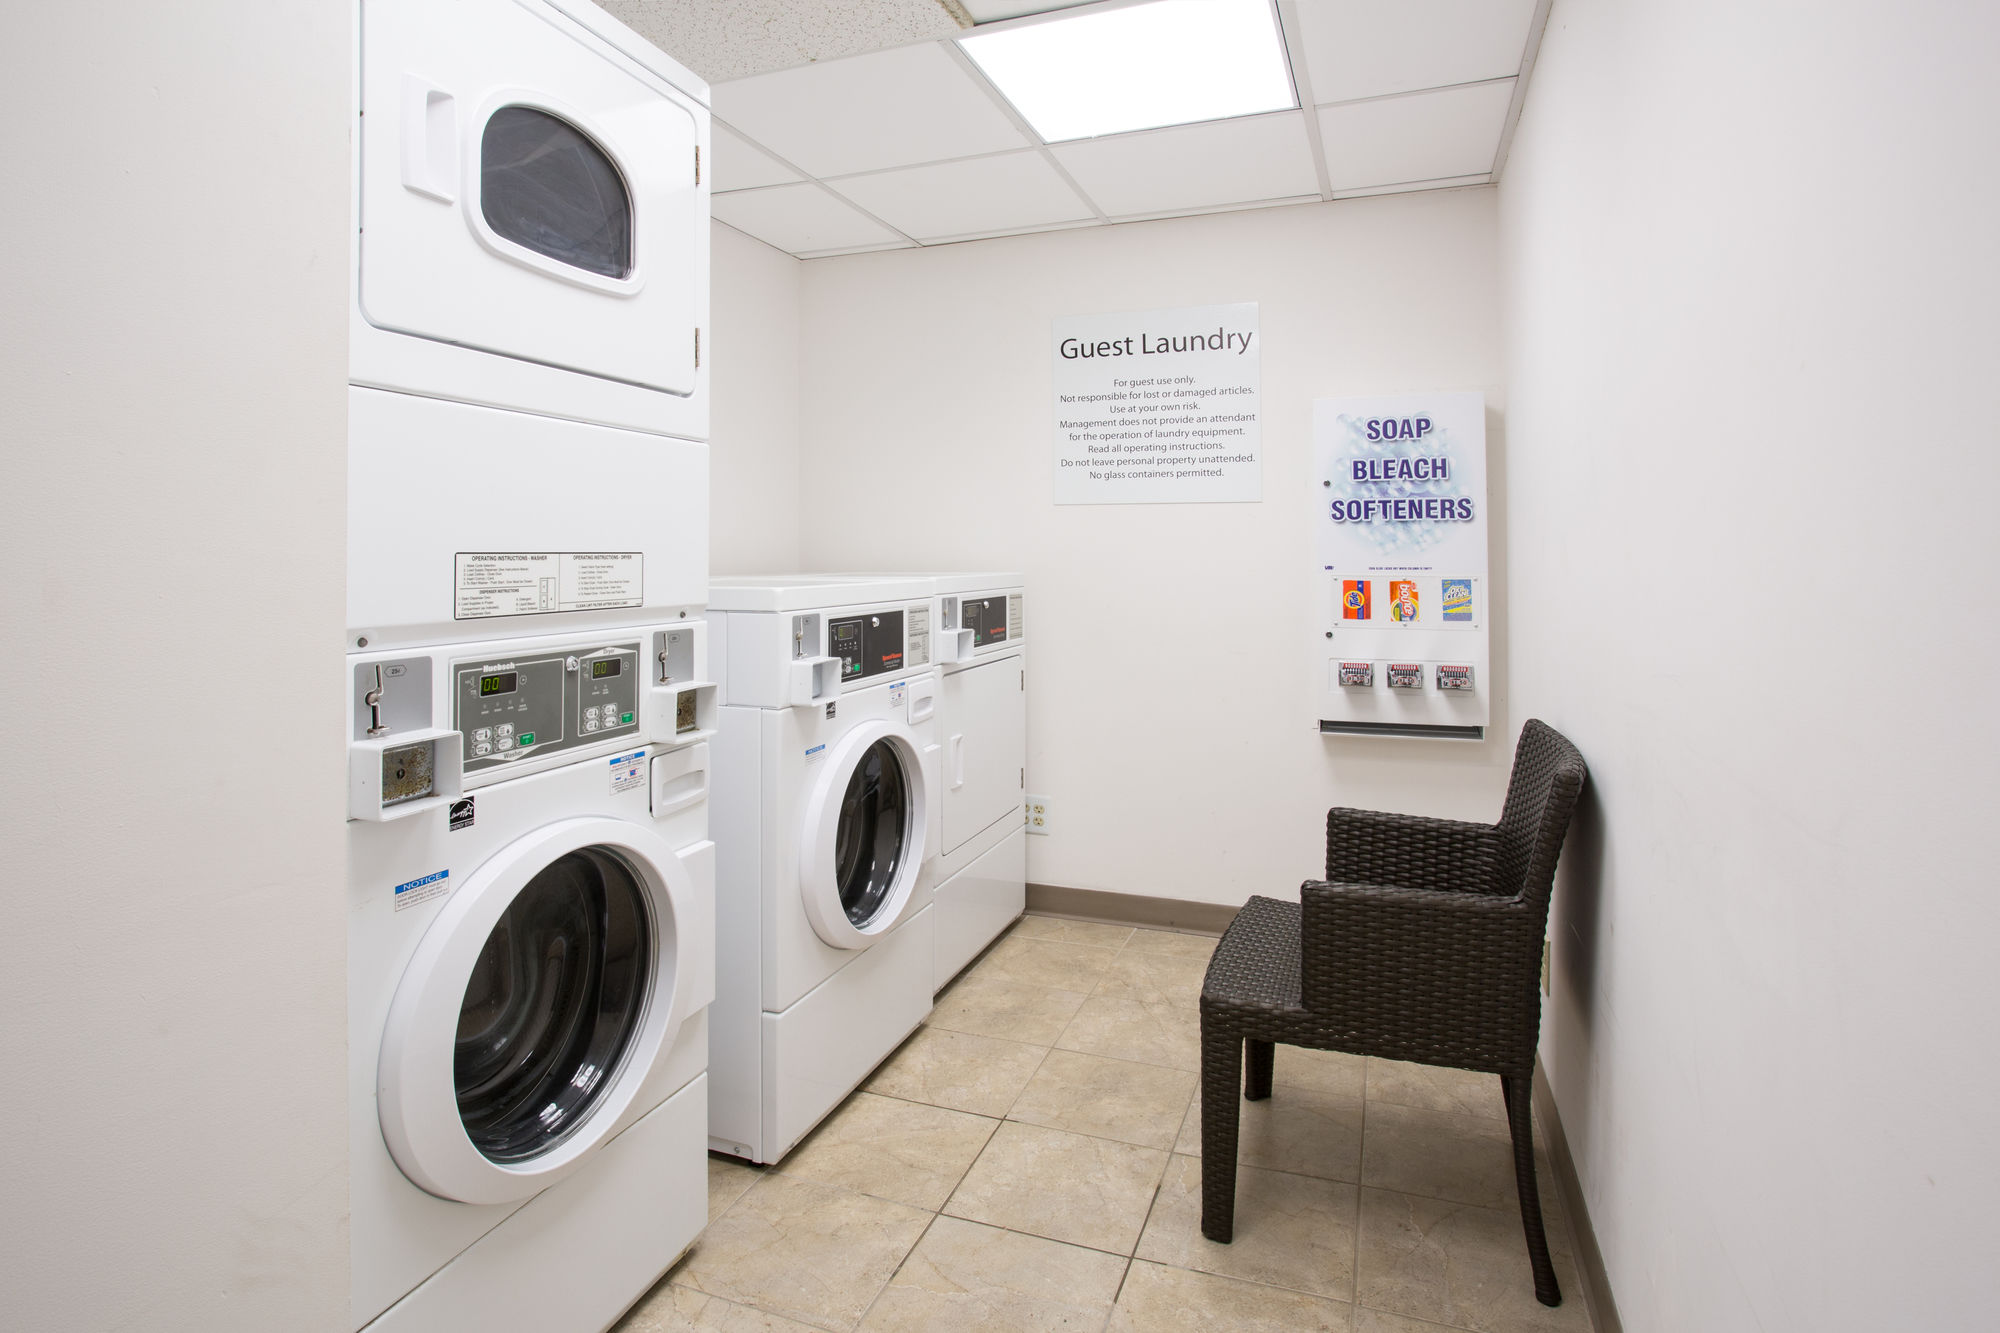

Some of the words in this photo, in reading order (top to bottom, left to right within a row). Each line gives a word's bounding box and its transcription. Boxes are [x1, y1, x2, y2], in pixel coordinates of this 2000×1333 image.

[1060, 337, 1134, 359] Guest
[1142, 327, 1252, 355] Laundry
[1114, 379, 1127, 387] For
[1130, 378, 1154, 388] guest
[1174, 376, 1196, 385] only.
[1078, 393, 1127, 403] responsible
[1129, 392, 1141, 400] for
[1143, 391, 1159, 399] lost
[1173, 388, 1217, 399] damaged
[1219, 386, 1254, 395] articles.
[1110, 405, 1125, 413] Use
[1138, 405, 1159, 414] your
[1183, 402, 1200, 410] risk.
[1060, 418, 1117, 429] Management
[1119, 418, 1140, 426] does
[1160, 416, 1194, 426] provide
[1209, 413, 1255, 422] attendant
[1100, 431, 1142, 441] operation
[1144, 430, 1153, 438] of
[1155, 429, 1190, 439] laundry
[1192, 428, 1245, 438] equipment.
[1367, 418, 1431, 441] SOAP
[1088, 445, 1110, 453] Read
[1111, 444, 1122, 452] all
[1124, 443, 1167, 453] operating
[1169, 441, 1225, 451] instructions.
[1092, 458, 1115, 466] leave
[1117, 457, 1155, 466] personal
[1157, 456, 1196, 465] property
[1198, 454, 1255, 463] unattended.
[1090, 471, 1102, 479] No
[1104, 471, 1126, 480] glass
[1128, 469, 1174, 478] containers
[1176, 469, 1224, 478] permitted.
[1352, 458, 1447, 480] BLEACH
[1331, 498, 1473, 521] SOFTENERS
[1349, 592, 1360, 606] Tide
[483, 662, 515, 672] Huebsch
[504, 750, 524, 759] Washer
[403, 873, 442, 891] NOTICE
